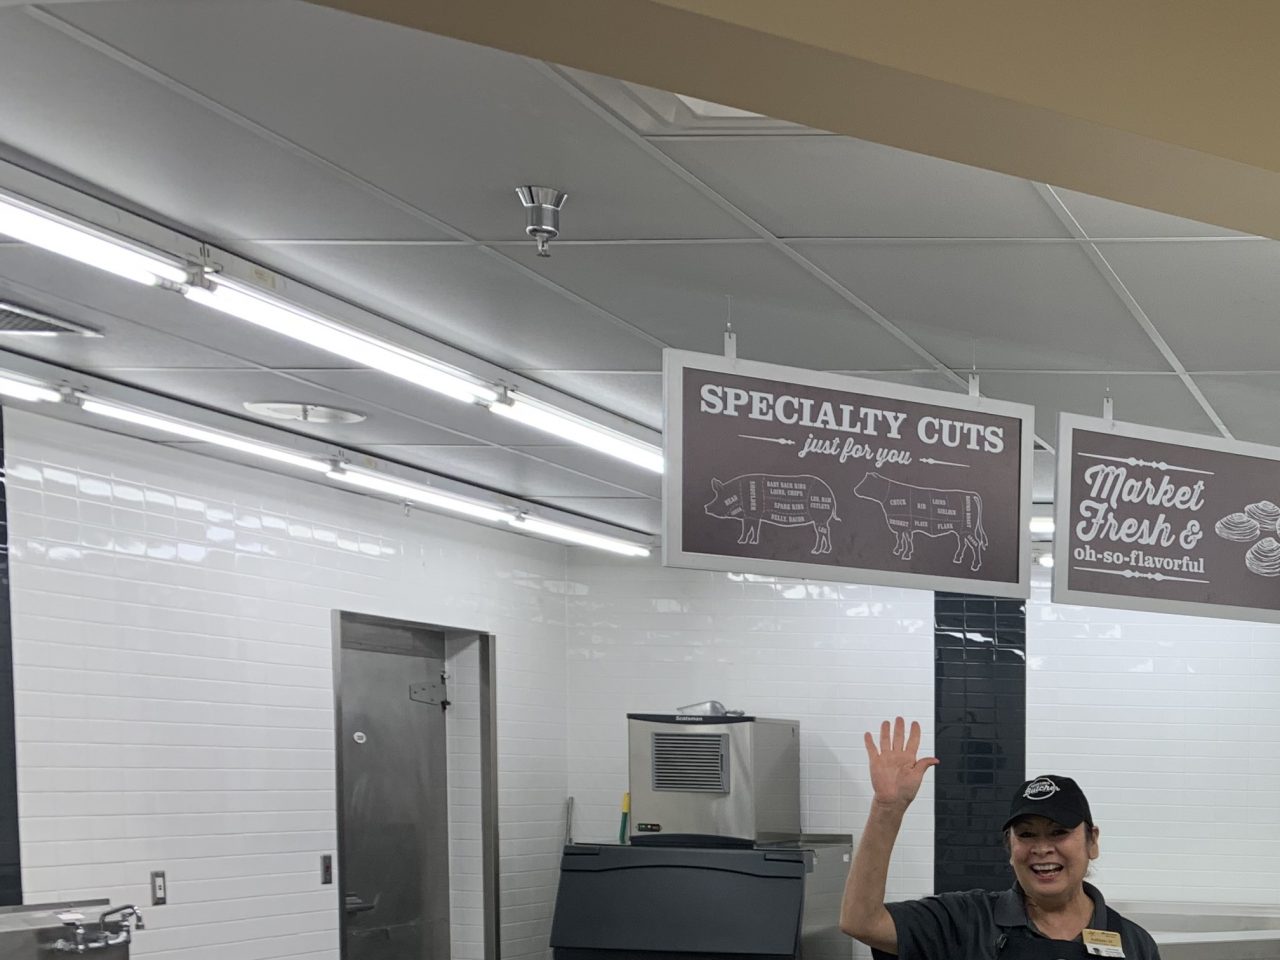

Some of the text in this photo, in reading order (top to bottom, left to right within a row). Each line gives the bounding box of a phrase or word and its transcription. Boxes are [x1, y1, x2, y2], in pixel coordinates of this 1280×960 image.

[700, 384, 1004, 453] SPECIALTY CUTS
[798, 434, 912, 467] just for you
[1084, 464, 1205, 511] Market
[1076, 500, 1203, 550] Fresh &
[1074, 545, 1205, 574] oh-so-flavorful
